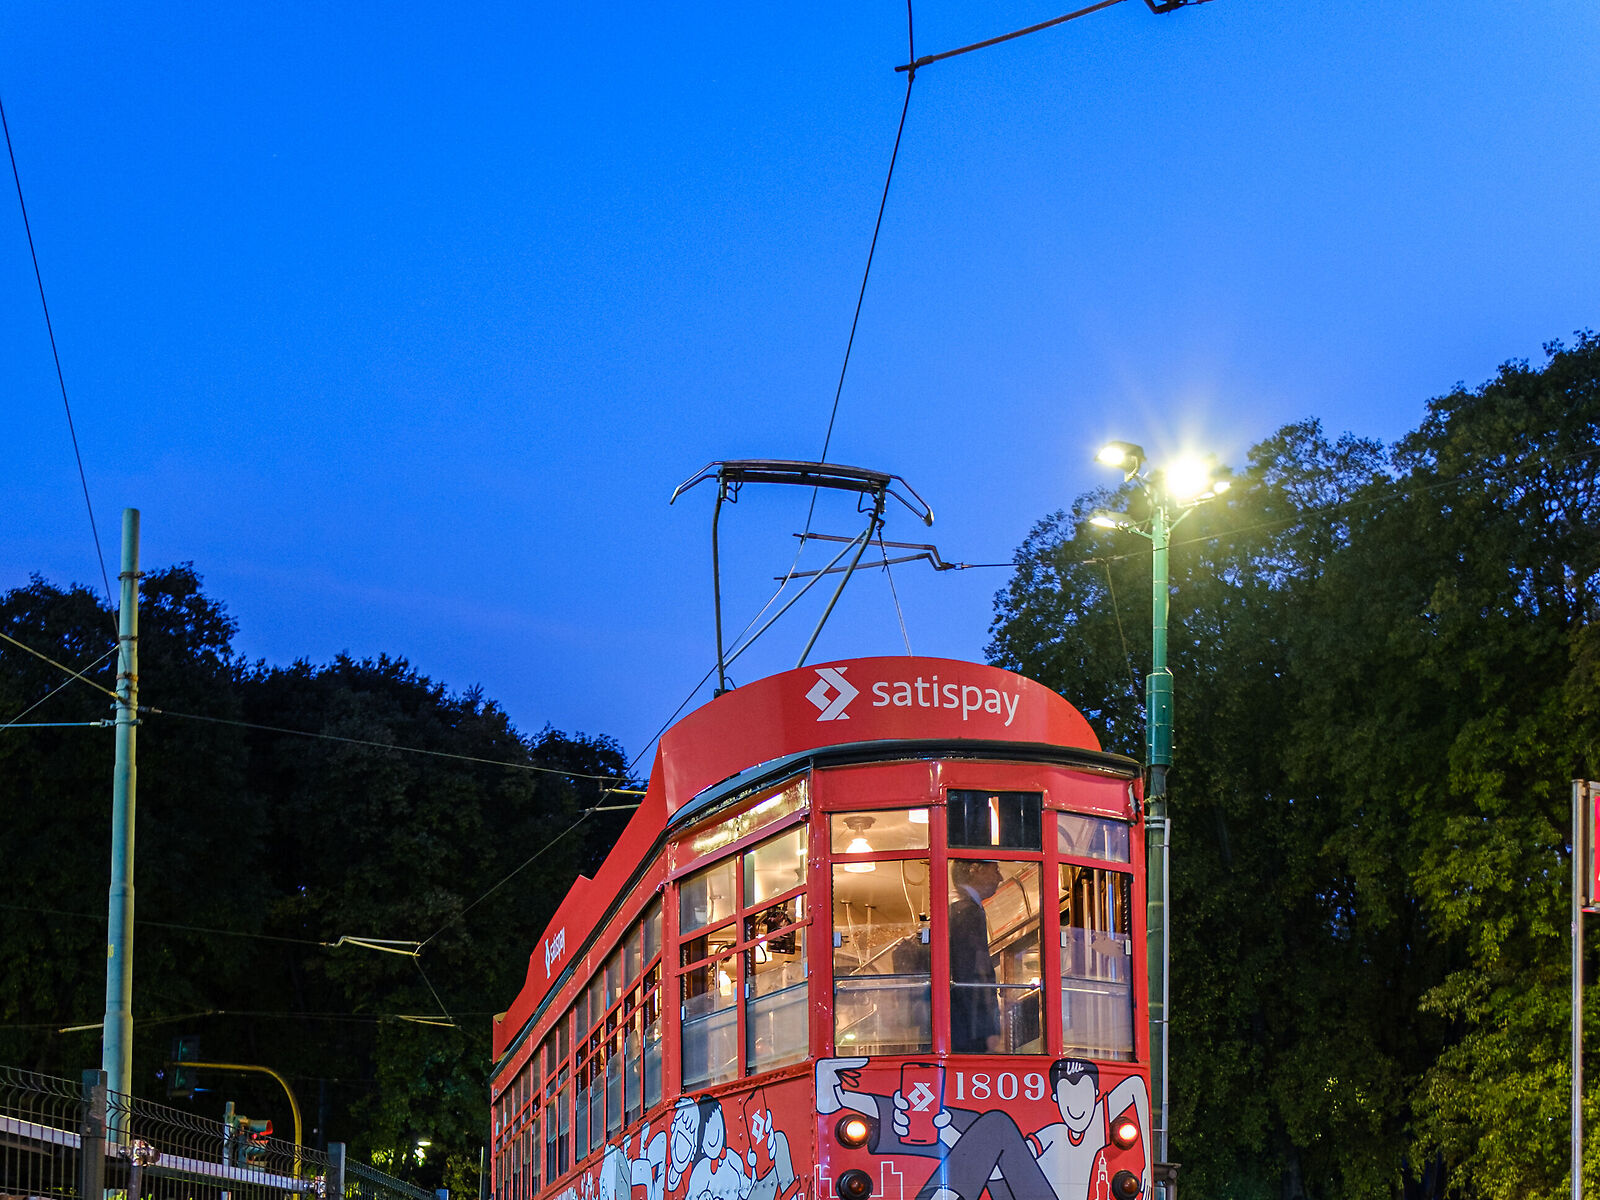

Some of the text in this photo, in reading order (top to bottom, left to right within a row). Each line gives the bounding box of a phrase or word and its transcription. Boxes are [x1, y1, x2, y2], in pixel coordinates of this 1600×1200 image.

[872, 675, 1020, 727] satispay
[988, 796, 1000, 846] 1
[955, 1071, 1046, 1101] 1809
